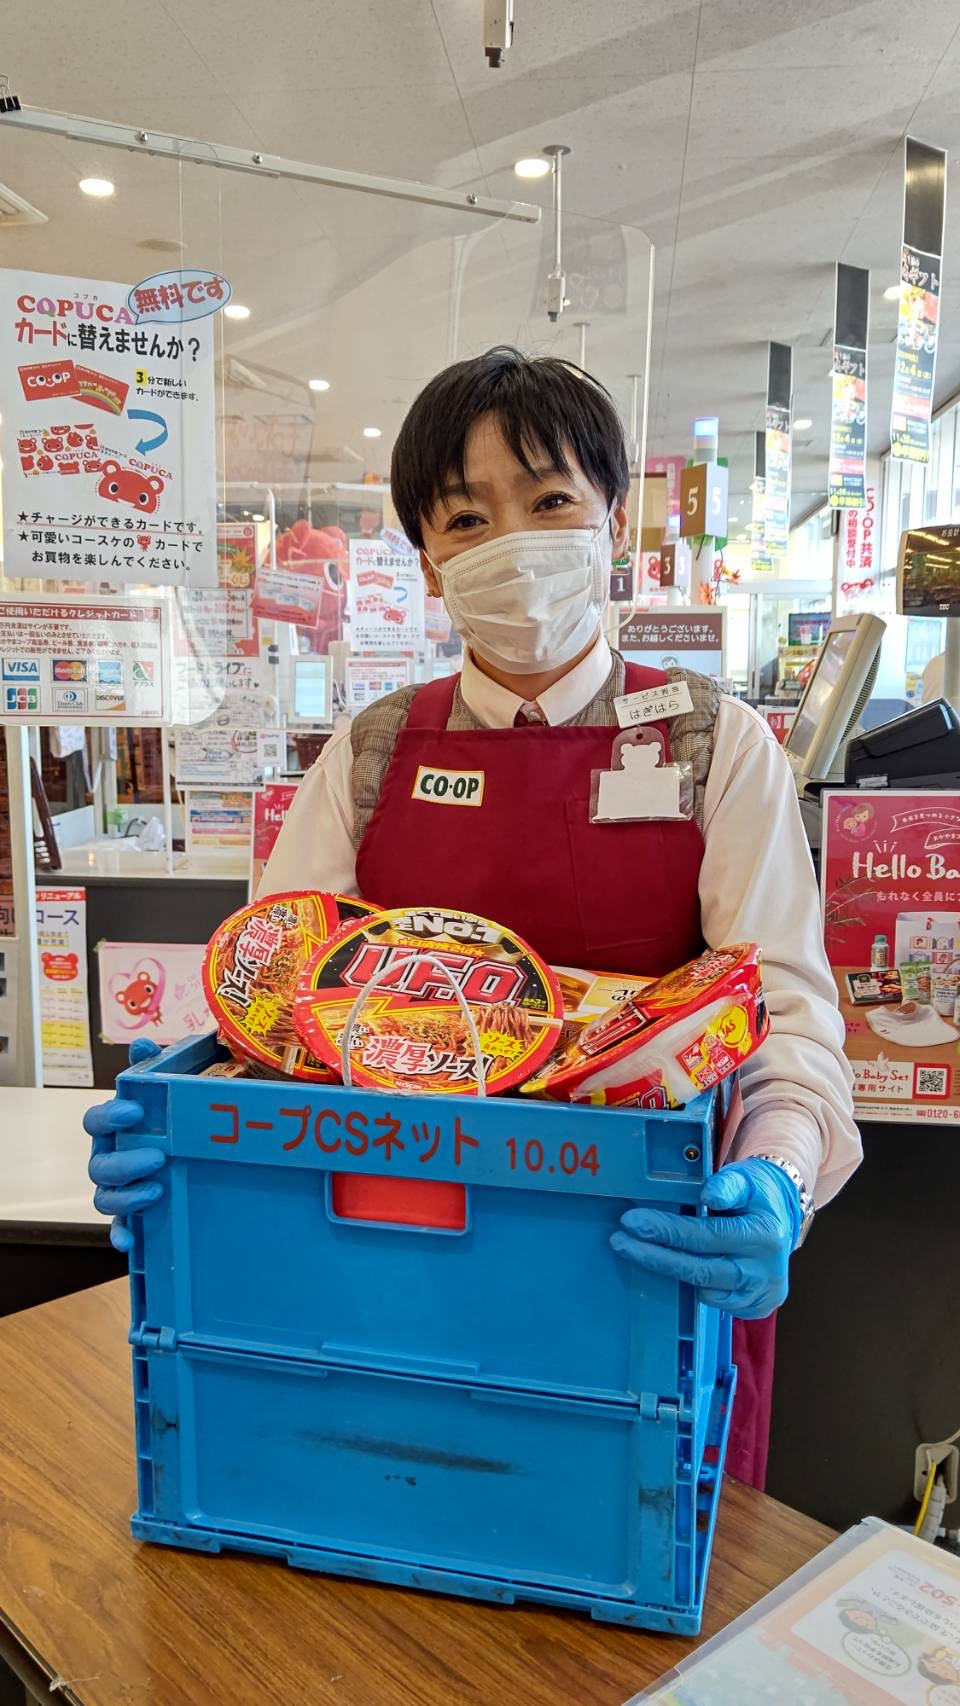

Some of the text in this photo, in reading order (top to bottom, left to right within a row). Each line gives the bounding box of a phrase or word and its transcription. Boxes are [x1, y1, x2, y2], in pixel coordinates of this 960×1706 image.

[134, 277, 224, 315] 無料です
[17, 295, 135, 325] COPUCA
[15, 317, 200, 362] カードに替えませんか？
[136, 386, 199, 401] カードができます。
[55, 451, 99, 461] COPUCA
[129, 458, 173, 480] COPUCA
[687, 486, 699, 516] 5
[711, 486, 722, 516] 5
[31, 511, 203, 535] チャージができるカードです。
[31, 530, 203, 553] 可愛いコースケの カードで
[32, 550, 192, 571] お買物を楽しんでください。
[664, 557, 671, 575] 3
[617, 577, 625, 592] 1
[621, 634, 719, 643] また、お越しくださいませ。
[627, 624, 713, 634] ありがとうございます。
[8, 662, 38, 673] VISA
[622, 686, 680, 704] サービス担当
[629, 700, 680, 720] はぎはら
[852, 851, 922, 880] Hello
[864, 1069, 887, 1082] Baby
[890, 1070, 909, 1080] Set
[853, 1083, 904, 1092] 専用サイト
[209, 1103, 601, 1176] コープCSネット 10.04
